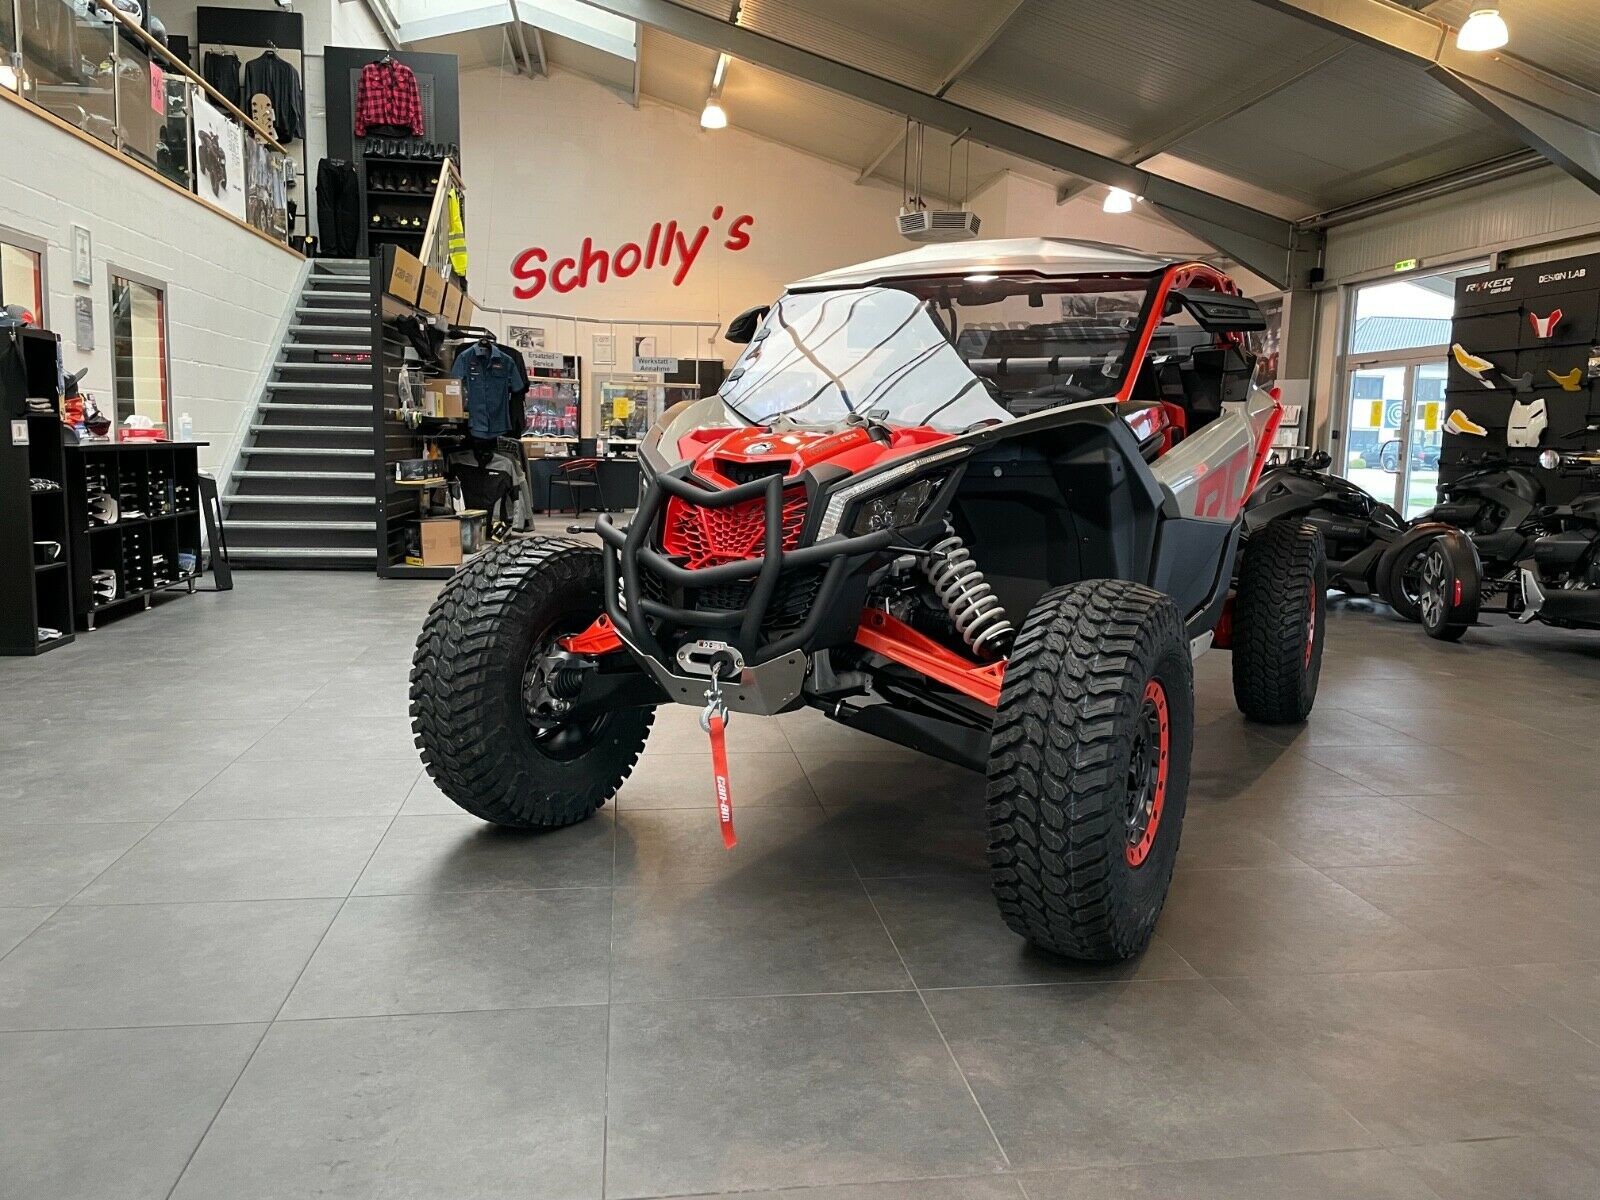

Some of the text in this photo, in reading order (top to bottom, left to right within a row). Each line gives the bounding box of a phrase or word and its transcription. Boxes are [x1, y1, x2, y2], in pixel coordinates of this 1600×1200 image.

[510, 205, 754, 299] Scholly's
[1538, 268, 1586, 283] DESIGN LAB
[1465, 277, 1514, 292] RYKER
